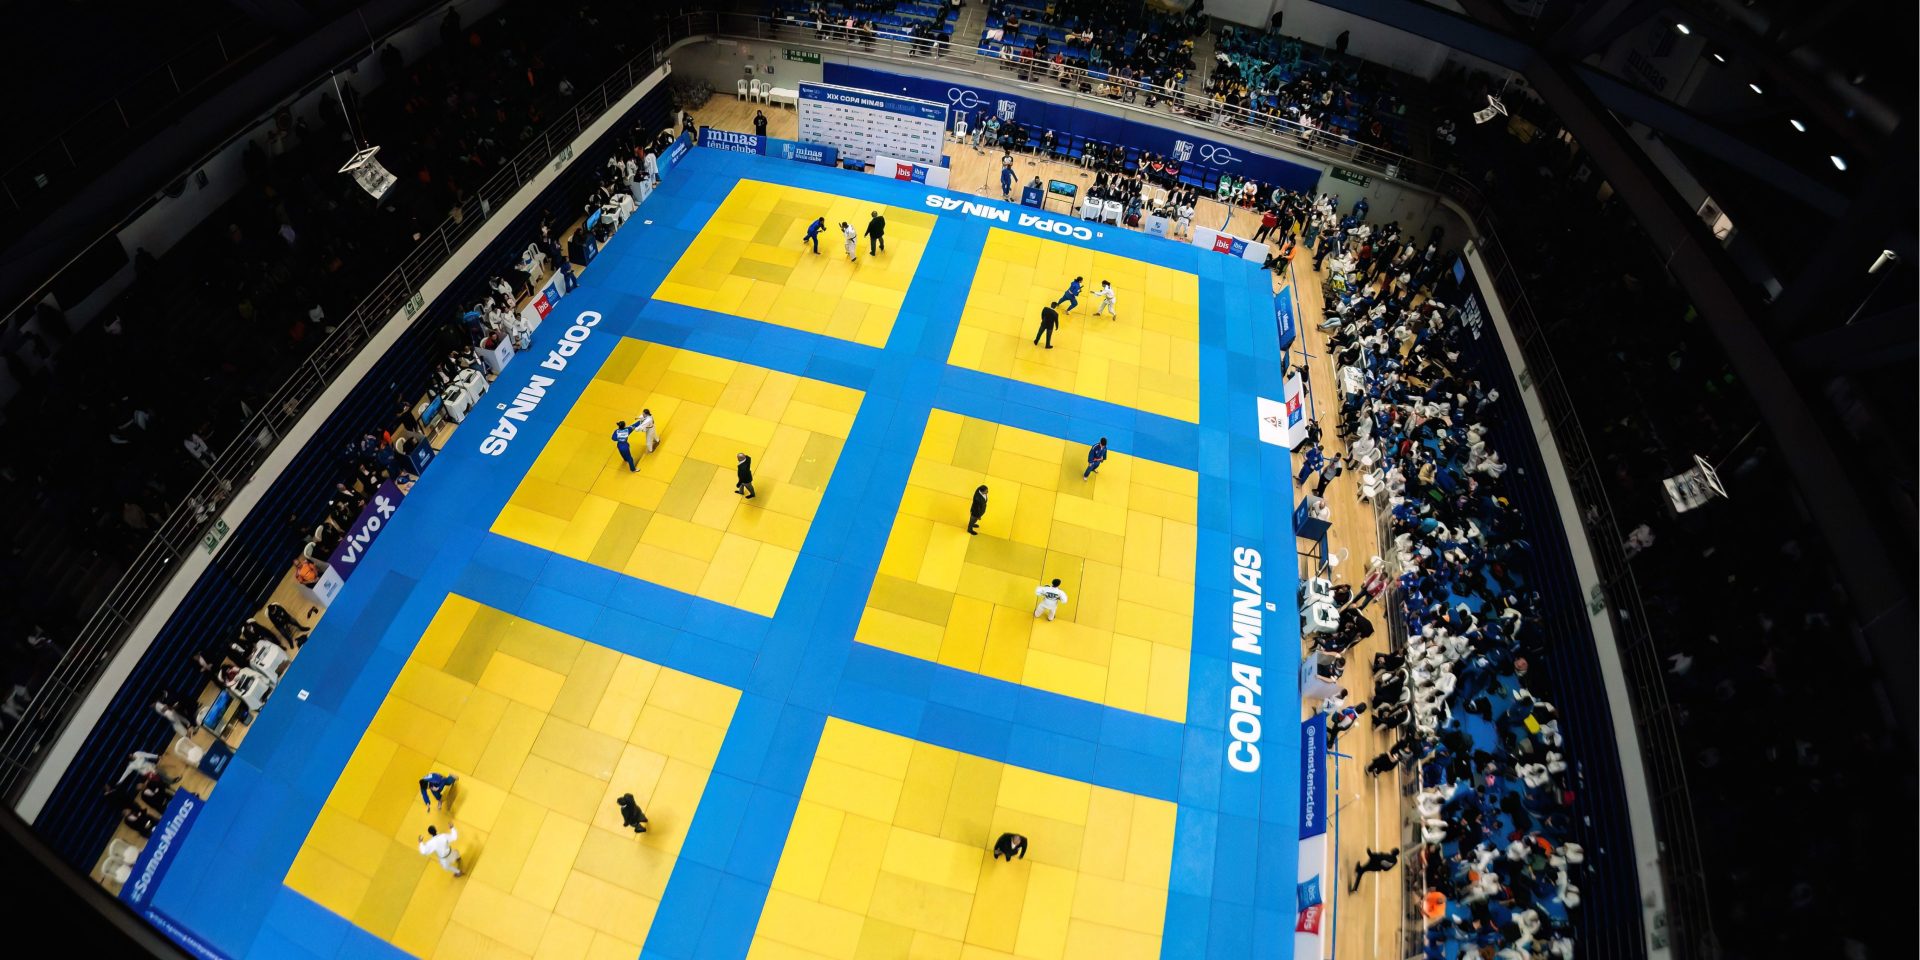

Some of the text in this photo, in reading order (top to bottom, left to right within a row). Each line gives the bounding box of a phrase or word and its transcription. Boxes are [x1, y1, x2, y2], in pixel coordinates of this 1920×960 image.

[840, 95, 860, 104] COPA
[861, 98, 884, 108] MINAS
[707, 130, 757, 146] minas
[707, 140, 757, 155] tênis clube
[796, 148, 823, 157] minas
[898, 167, 911, 177] ibis
[925, 194, 1093, 241] COPA MINAS
[1216, 239, 1229, 249] ibis
[537, 301, 549, 314] ibis
[479, 311, 602, 456] COPA MINAS
[341, 516, 381, 563] vivo
[1228, 546, 1262, 773] COPA MINAS
[1305, 725, 1316, 827] @minastenisclube
